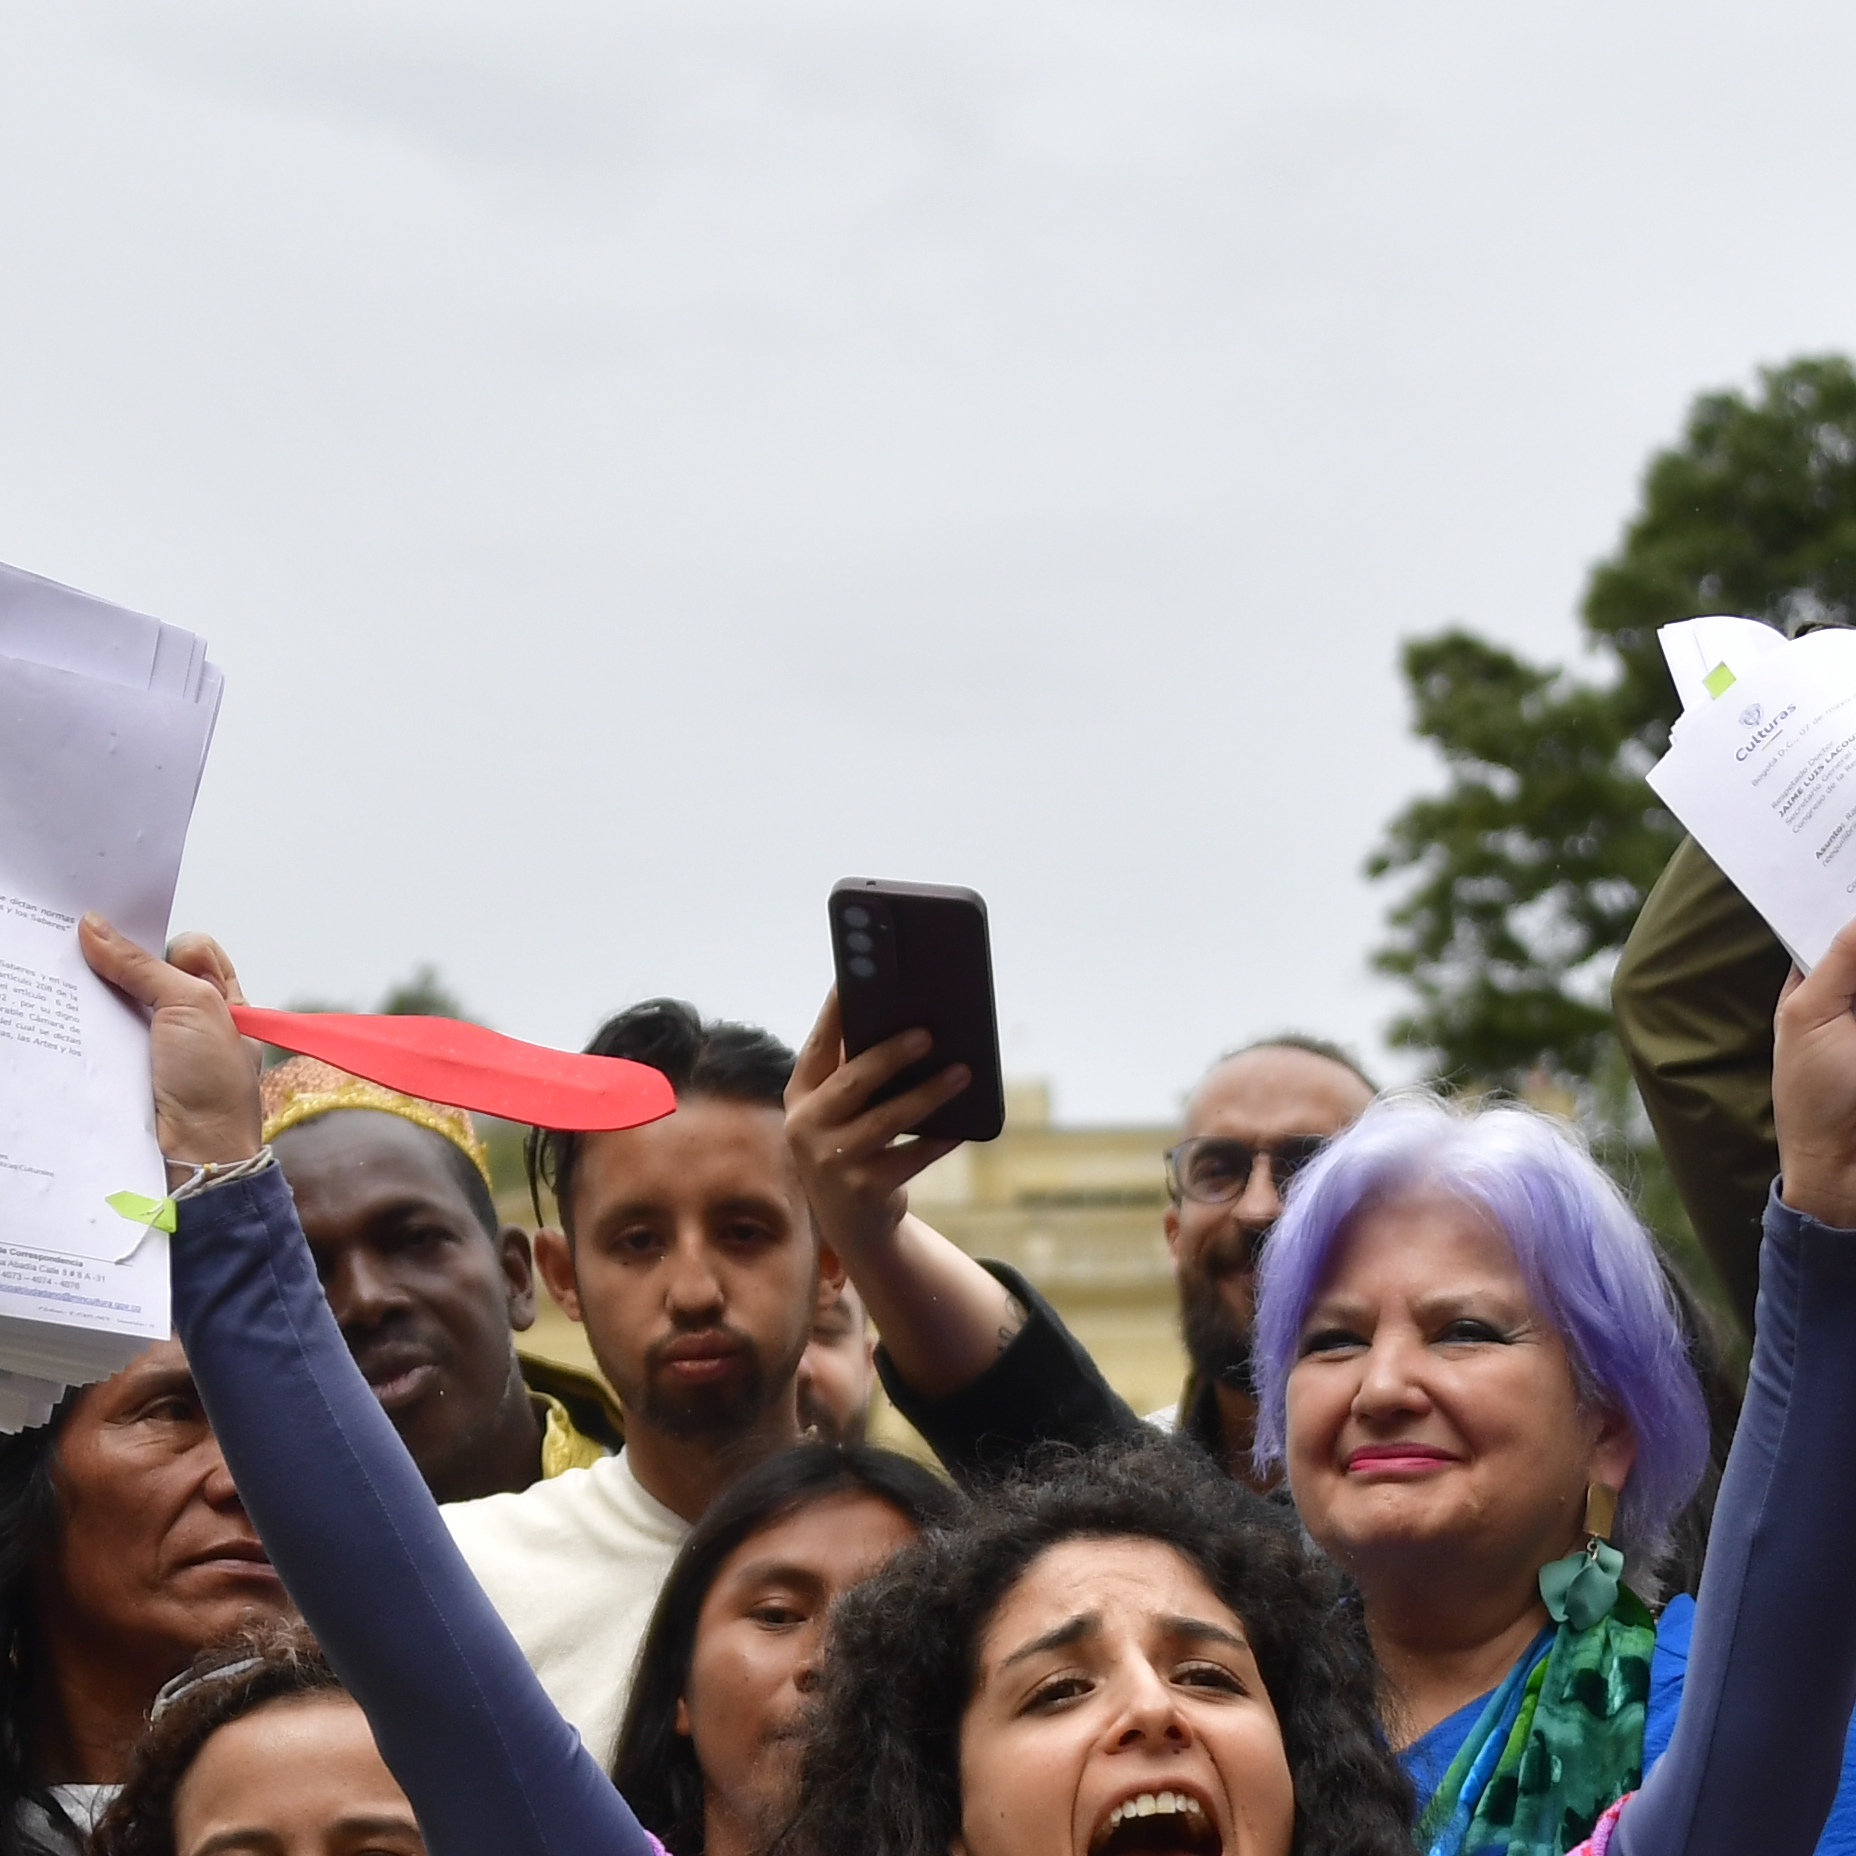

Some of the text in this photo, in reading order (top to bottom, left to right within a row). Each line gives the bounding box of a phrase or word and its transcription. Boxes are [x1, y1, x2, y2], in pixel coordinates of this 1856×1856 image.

[1735, 703, 1797, 762] Culturas
[1777, 786, 1805, 819] JAIME
[1801, 763, 1826, 788] LUIS
[1814, 821, 1846, 861] Asunto:
[8, 896, 38, 913] dictan
[39, 906, 76, 925] normas
[13, 906, 29, 919] los
[7, 1246, 85, 1269] Correspondencia
